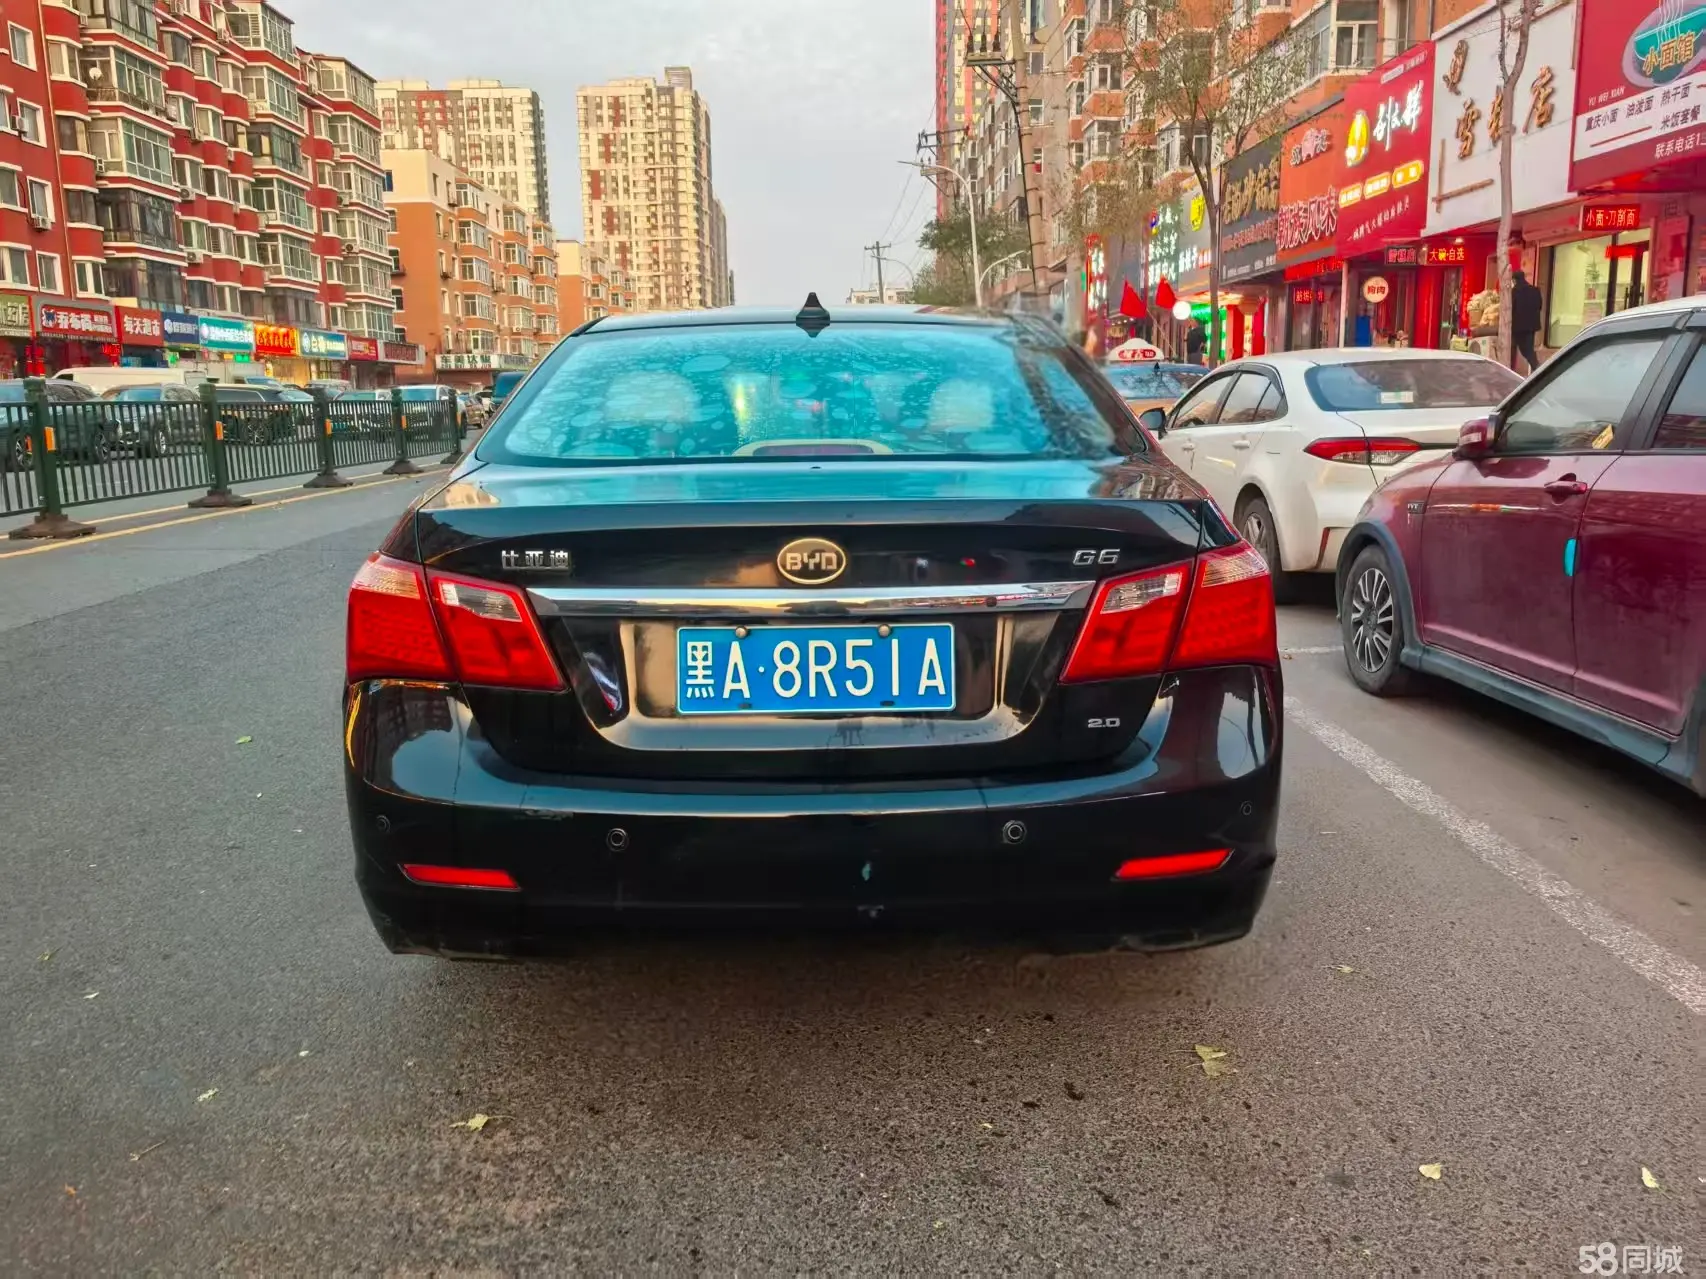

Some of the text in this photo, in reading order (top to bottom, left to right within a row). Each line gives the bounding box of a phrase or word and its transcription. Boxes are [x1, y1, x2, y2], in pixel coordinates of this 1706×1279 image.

[1642, 30, 1696, 76] 小面馆
[1585, 107, 1619, 132] 重庆小面
[1660, 82, 1692, 107] 热干面
[1660, 104, 1701, 131] 米饭套餐
[501, 550, 569, 570] 比亚迪
[786, 552, 838, 570] BYD
[1073, 549, 1120, 565] G6
